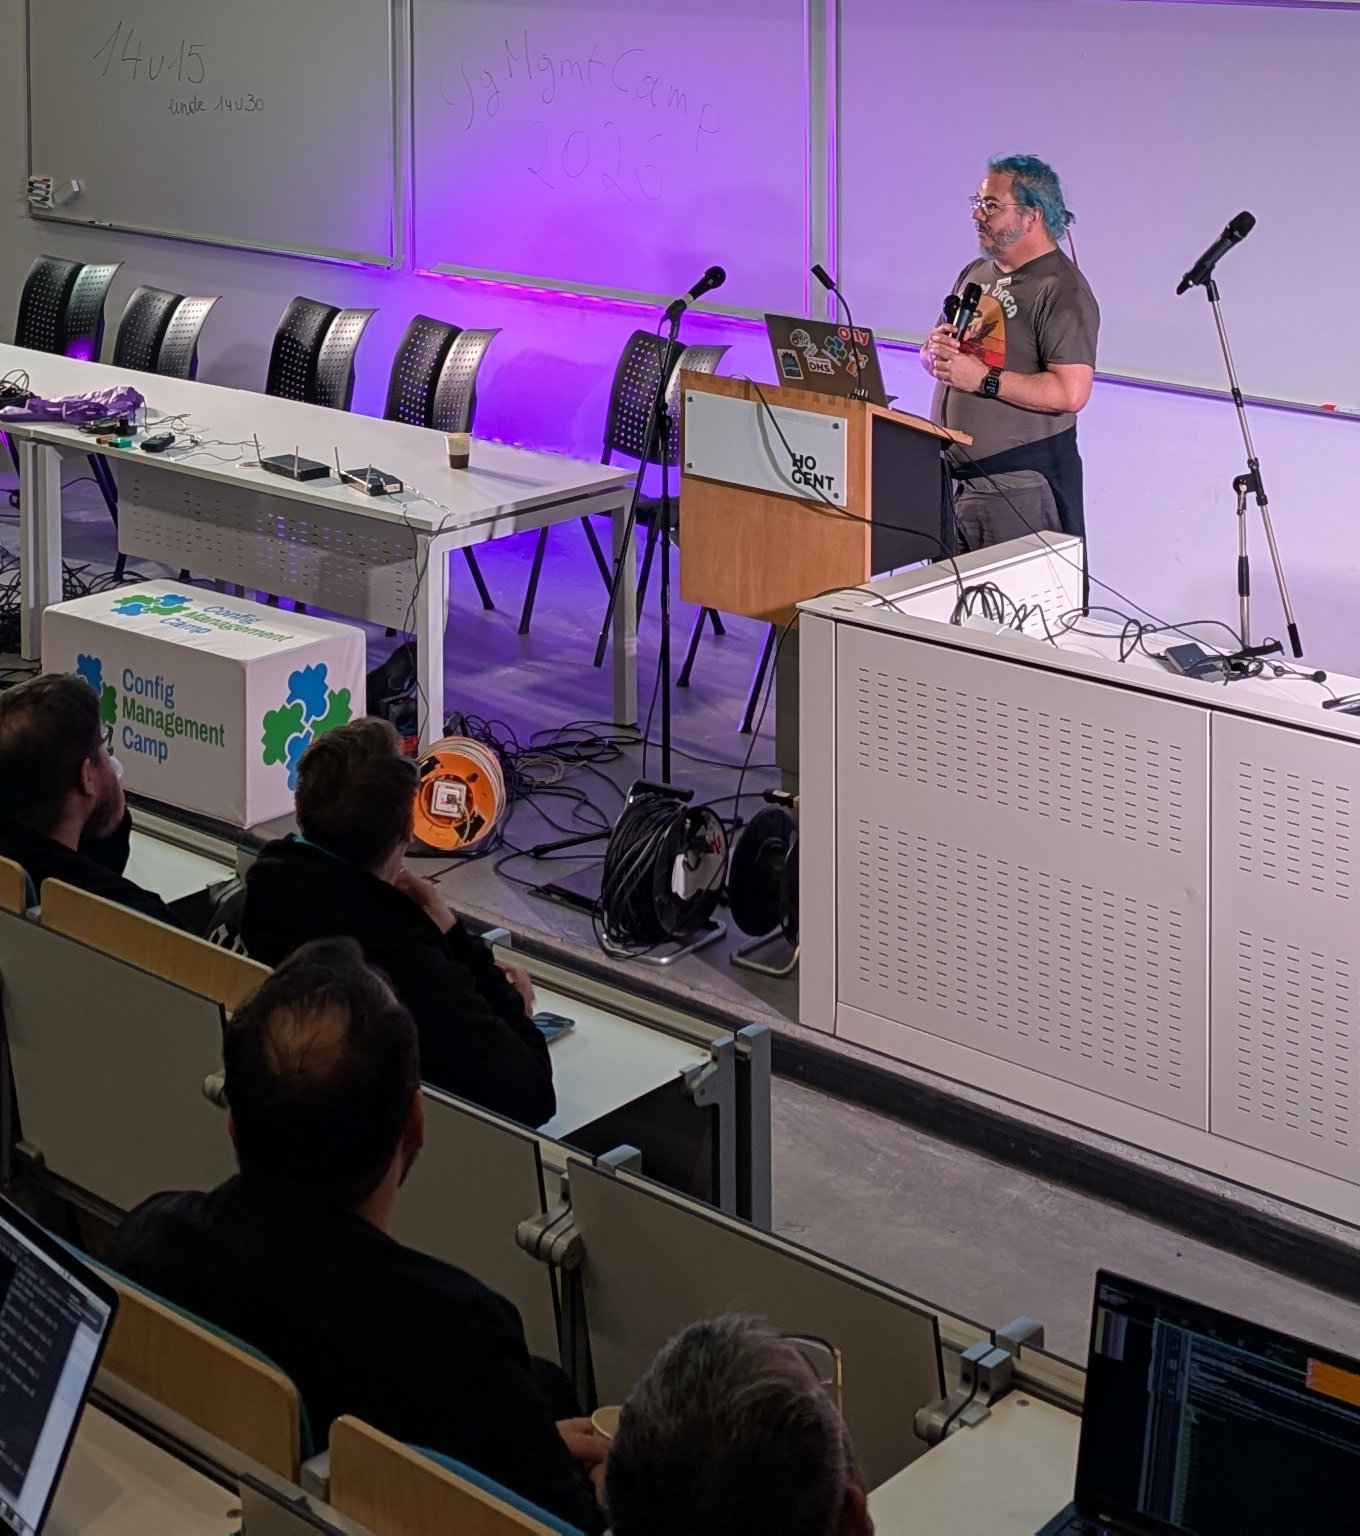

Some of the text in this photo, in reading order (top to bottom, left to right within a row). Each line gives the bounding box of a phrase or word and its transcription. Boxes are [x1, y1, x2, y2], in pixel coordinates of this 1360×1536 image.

[527, 120, 664, 201] 2026
[791, 452, 817, 470] HO
[791, 469, 835, 491] GENT
[159, 617, 213, 634] Camp
[180, 610, 294, 643] Management
[203, 605, 264, 625] Config
[121, 667, 175, 710] Config
[121, 695, 226, 749] Management
[121, 724, 169, 764] Camp
